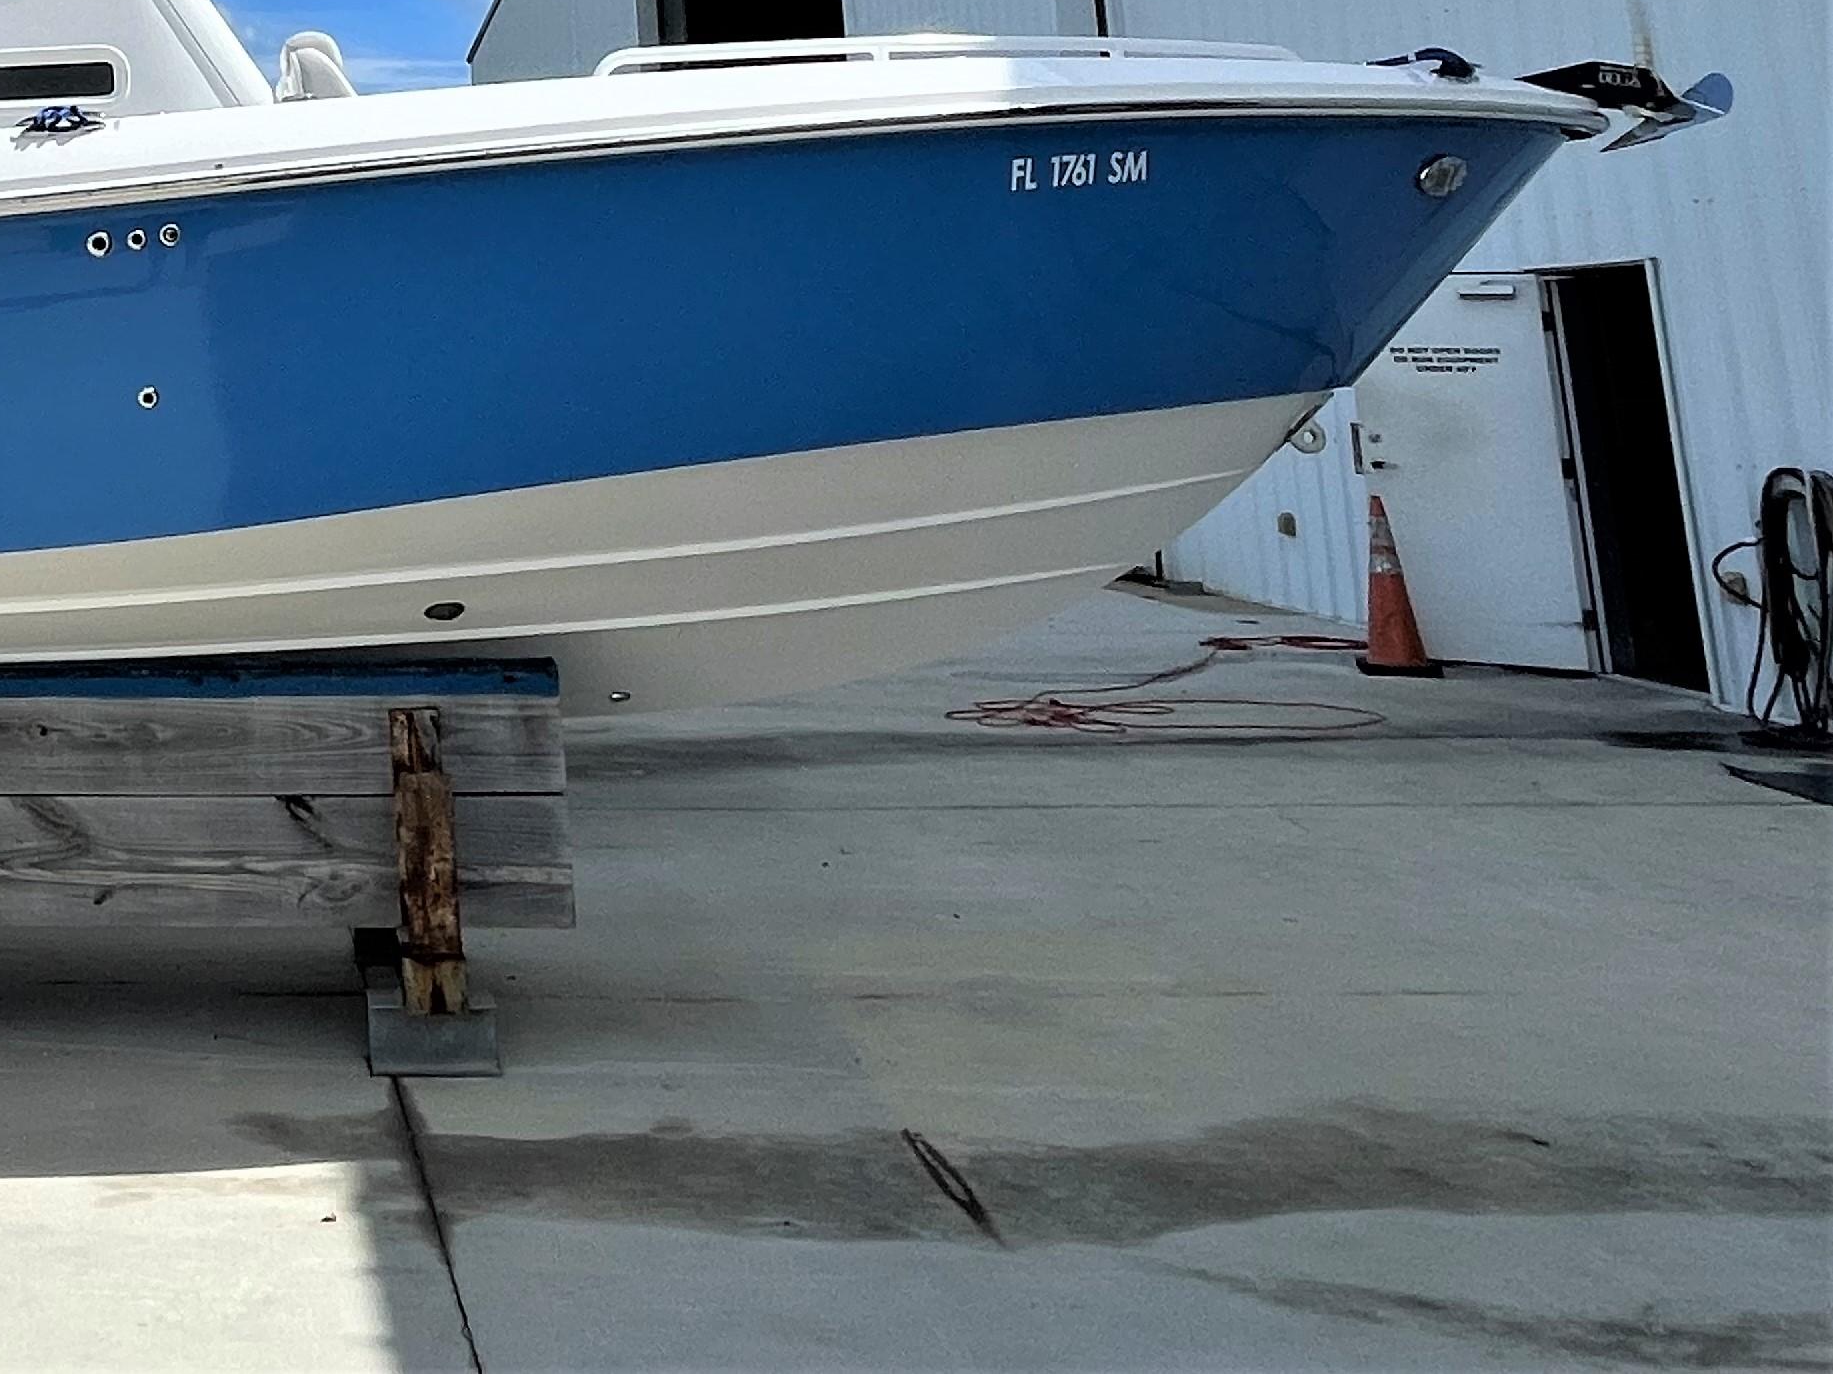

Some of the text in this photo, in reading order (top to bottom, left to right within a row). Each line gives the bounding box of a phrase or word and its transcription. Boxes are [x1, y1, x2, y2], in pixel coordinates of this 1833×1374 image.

[1011, 150, 1147, 191] FL 1761 SM
